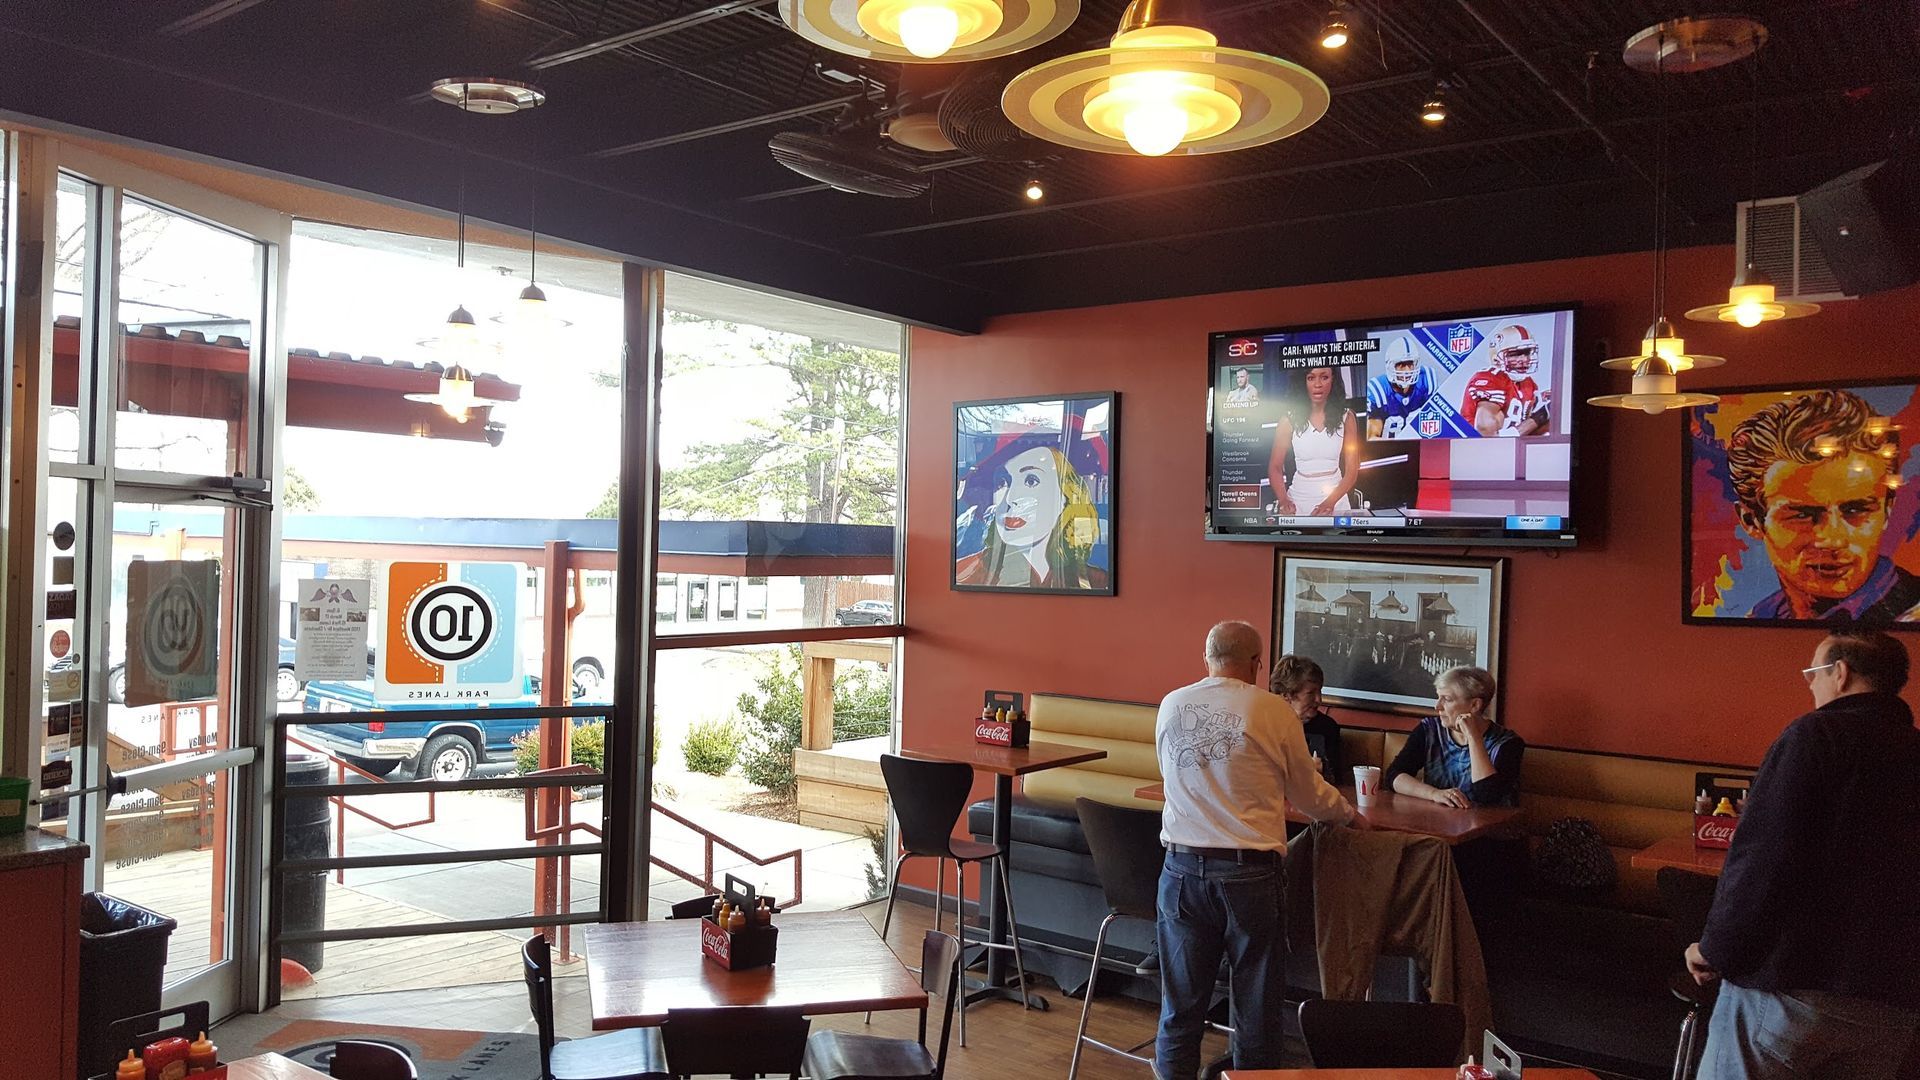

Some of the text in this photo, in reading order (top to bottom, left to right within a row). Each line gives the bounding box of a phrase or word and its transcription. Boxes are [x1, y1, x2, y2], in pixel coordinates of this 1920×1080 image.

[1229, 342, 1257, 356] SC
[1282, 340, 1377, 356] CARI: WHAT'S THE CRITERIA.
[1451, 338, 1470, 352] NFL
[1282, 354, 1364, 368] THAT'S WHAT T.O. ASKED.
[1426, 341, 1456, 371] HARRISON
[1433, 395, 1454, 417] OWENS
[1422, 421, 1439, 434] NFL
[1243, 517, 1258, 525] NBA
[1408, 518, 1423, 526] 7 ET
[976, 724, 1009, 741] Coca-Cola
[704, 928, 729, 960] Coca-Cola
[461, 1041, 511, 1071] LANES
